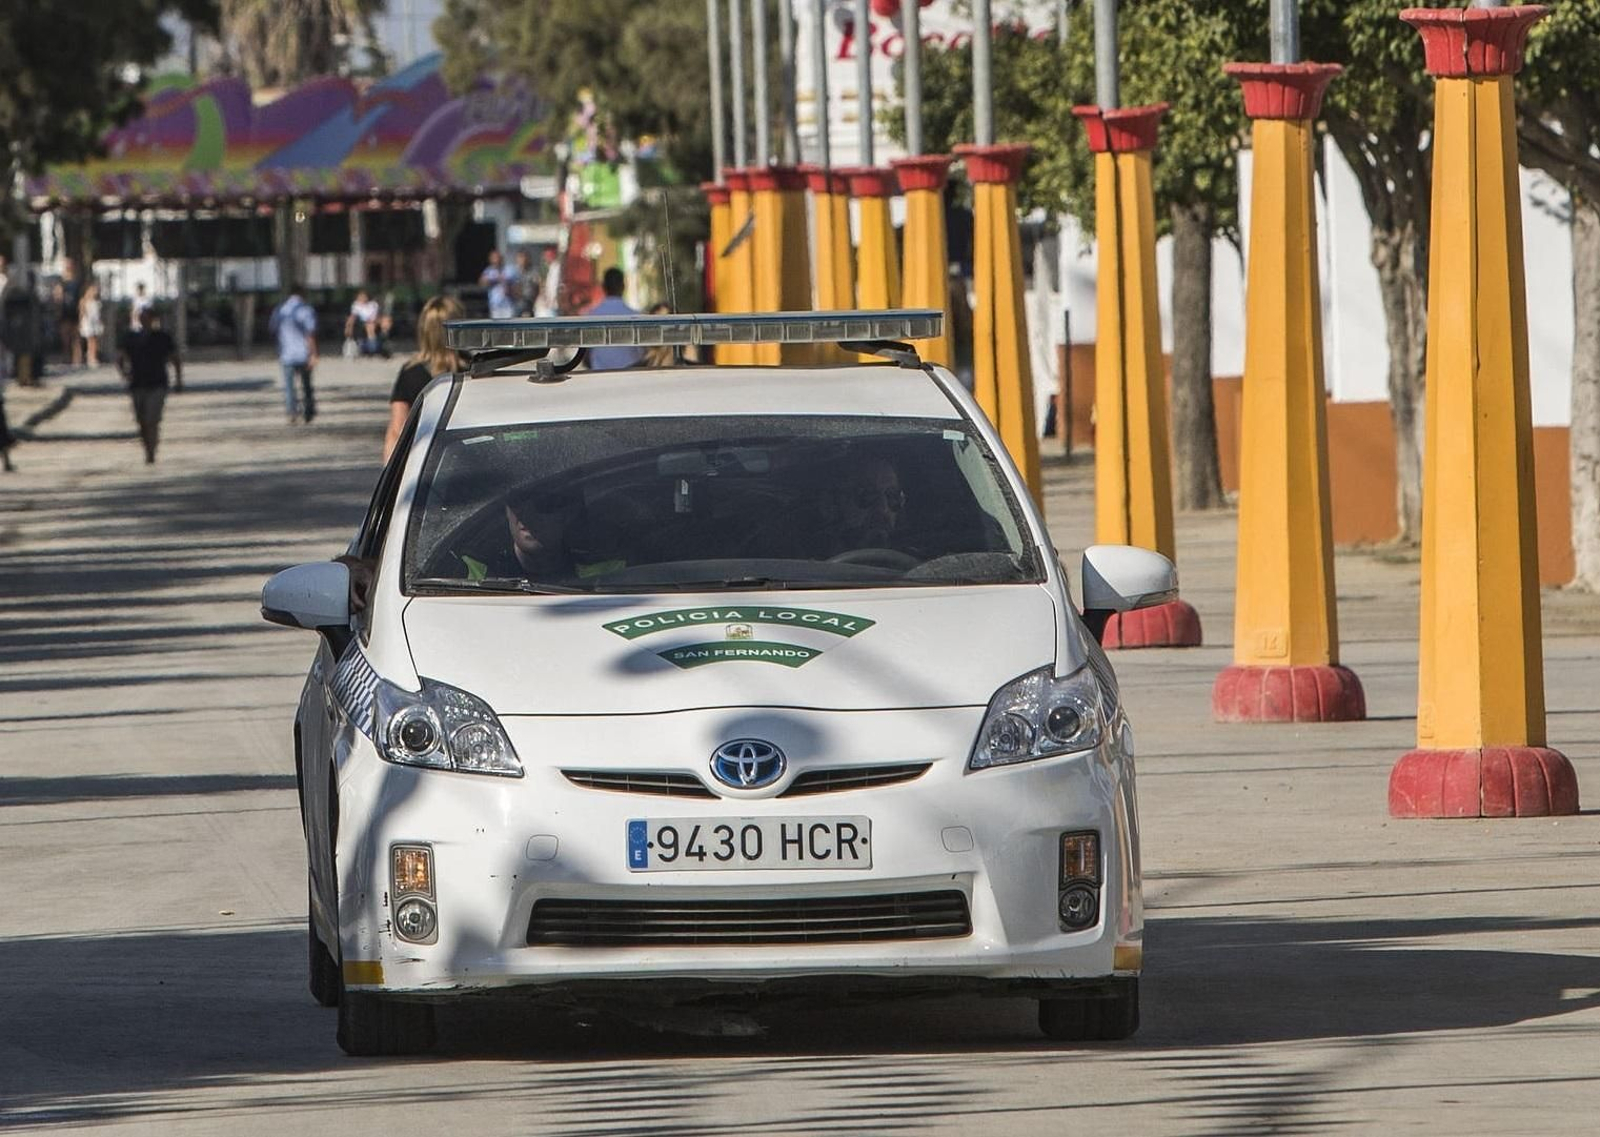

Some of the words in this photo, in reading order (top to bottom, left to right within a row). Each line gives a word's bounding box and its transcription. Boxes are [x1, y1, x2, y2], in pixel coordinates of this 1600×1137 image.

[613, 610, 743, 634] POLICIA
[758, 610, 857, 631] LOCAL
[673, 647, 709, 659] SAN
[714, 648, 810, 658] FERNANDO
[656, 824, 763, 863] 9430
[780, 822, 860, 861] HCR
[634, 850, 642, 861] E
